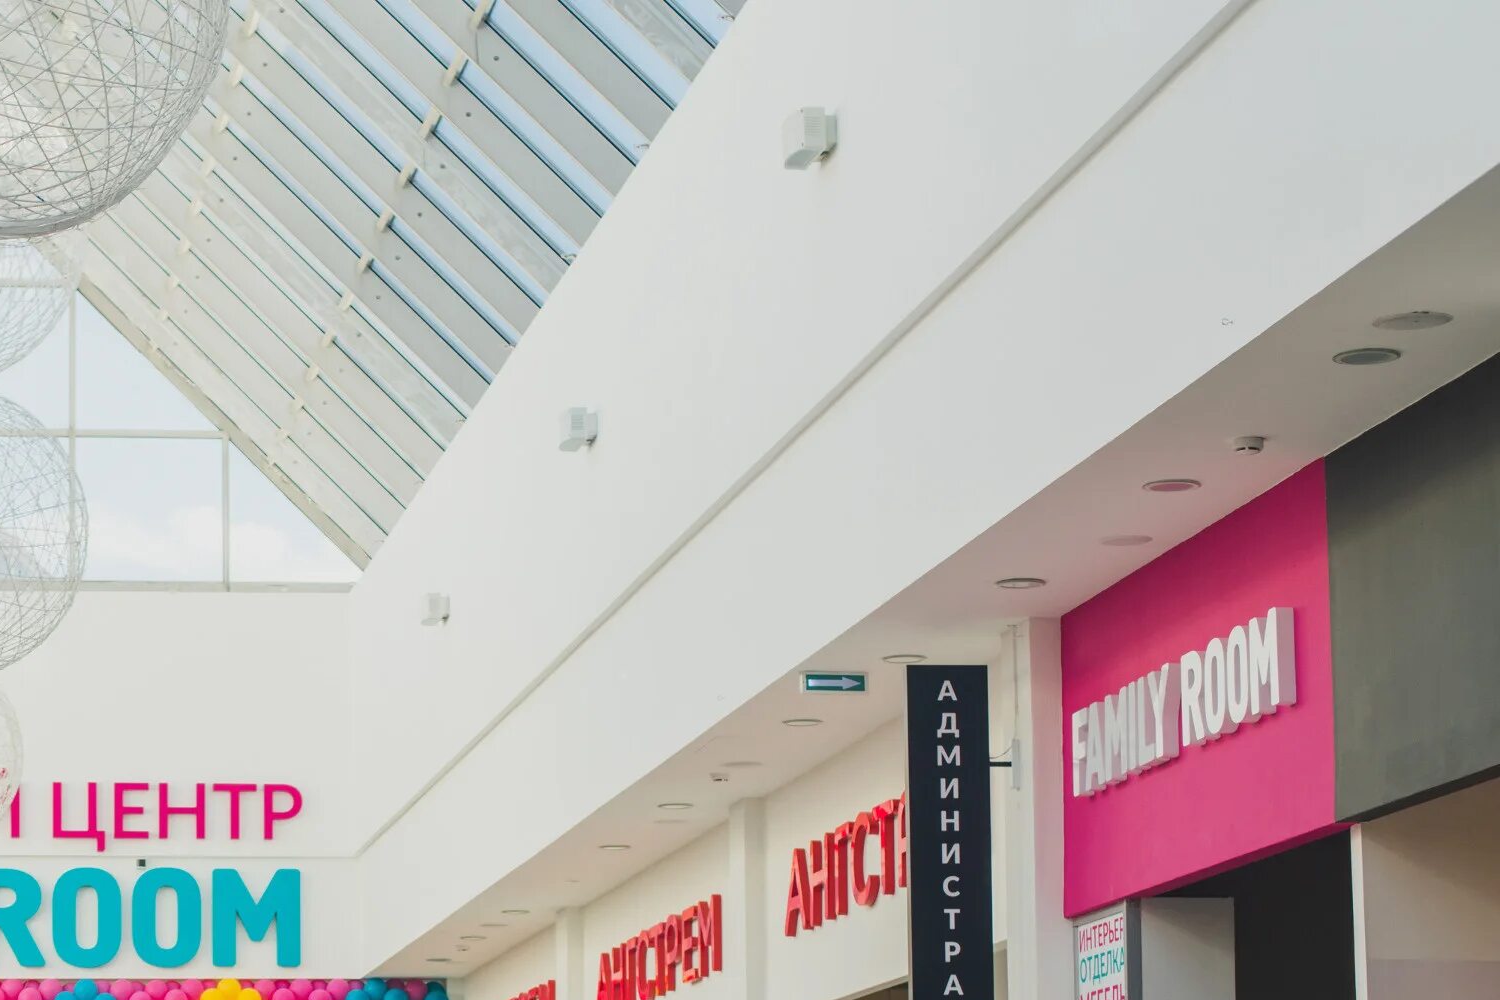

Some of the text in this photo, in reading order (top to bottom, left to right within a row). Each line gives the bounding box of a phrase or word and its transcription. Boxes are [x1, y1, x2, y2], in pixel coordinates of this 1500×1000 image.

[1072, 607, 1290, 797] FAMILY ROOM
[52, 782, 303, 852] ЦЕНТР
[1080, 946, 1124, 986] ОТДЕЛКА
